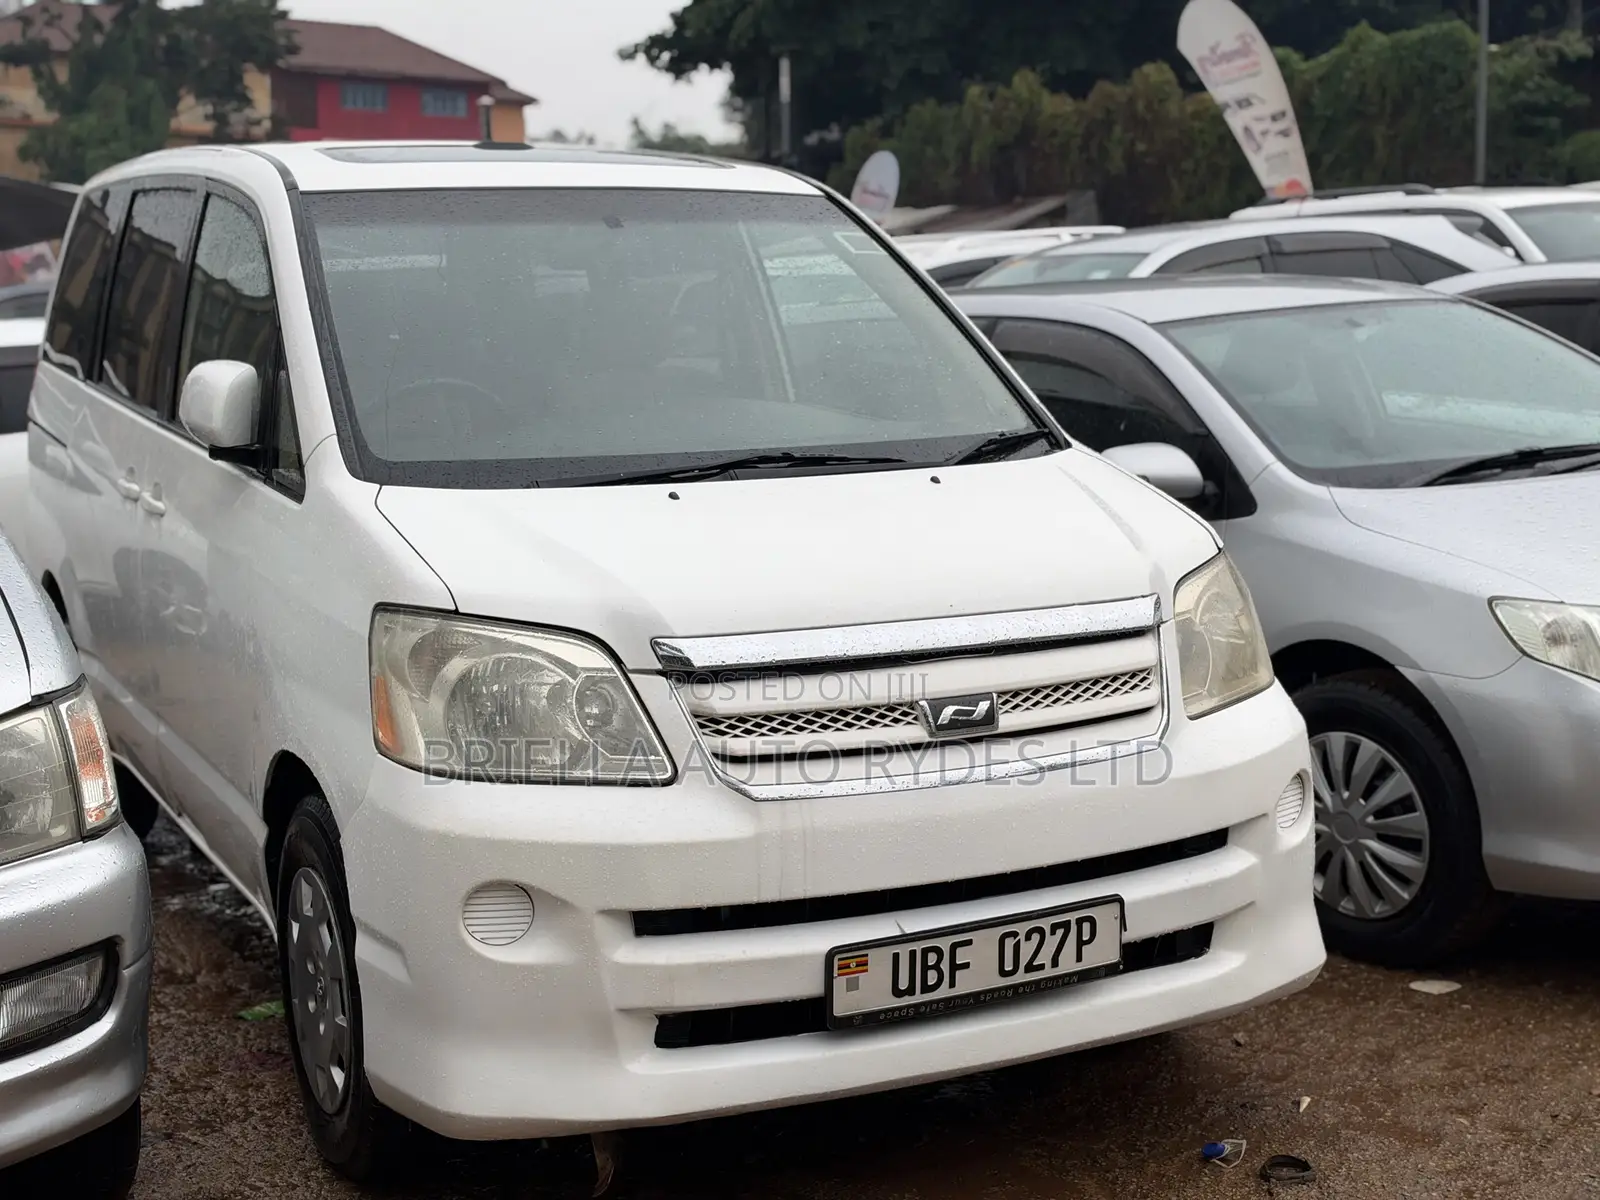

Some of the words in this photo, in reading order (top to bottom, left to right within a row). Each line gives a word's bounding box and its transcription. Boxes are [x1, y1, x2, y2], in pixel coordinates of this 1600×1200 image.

[892, 939, 974, 998] UBF
[998, 915, 1098, 977] 027P
[1040, 974, 1079, 989] Making
[980, 988, 1014, 1001] Roads
[1018, 984, 1036, 993] the
[879, 1007, 916, 1020] Space
[920, 1001, 945, 1013] Safe
